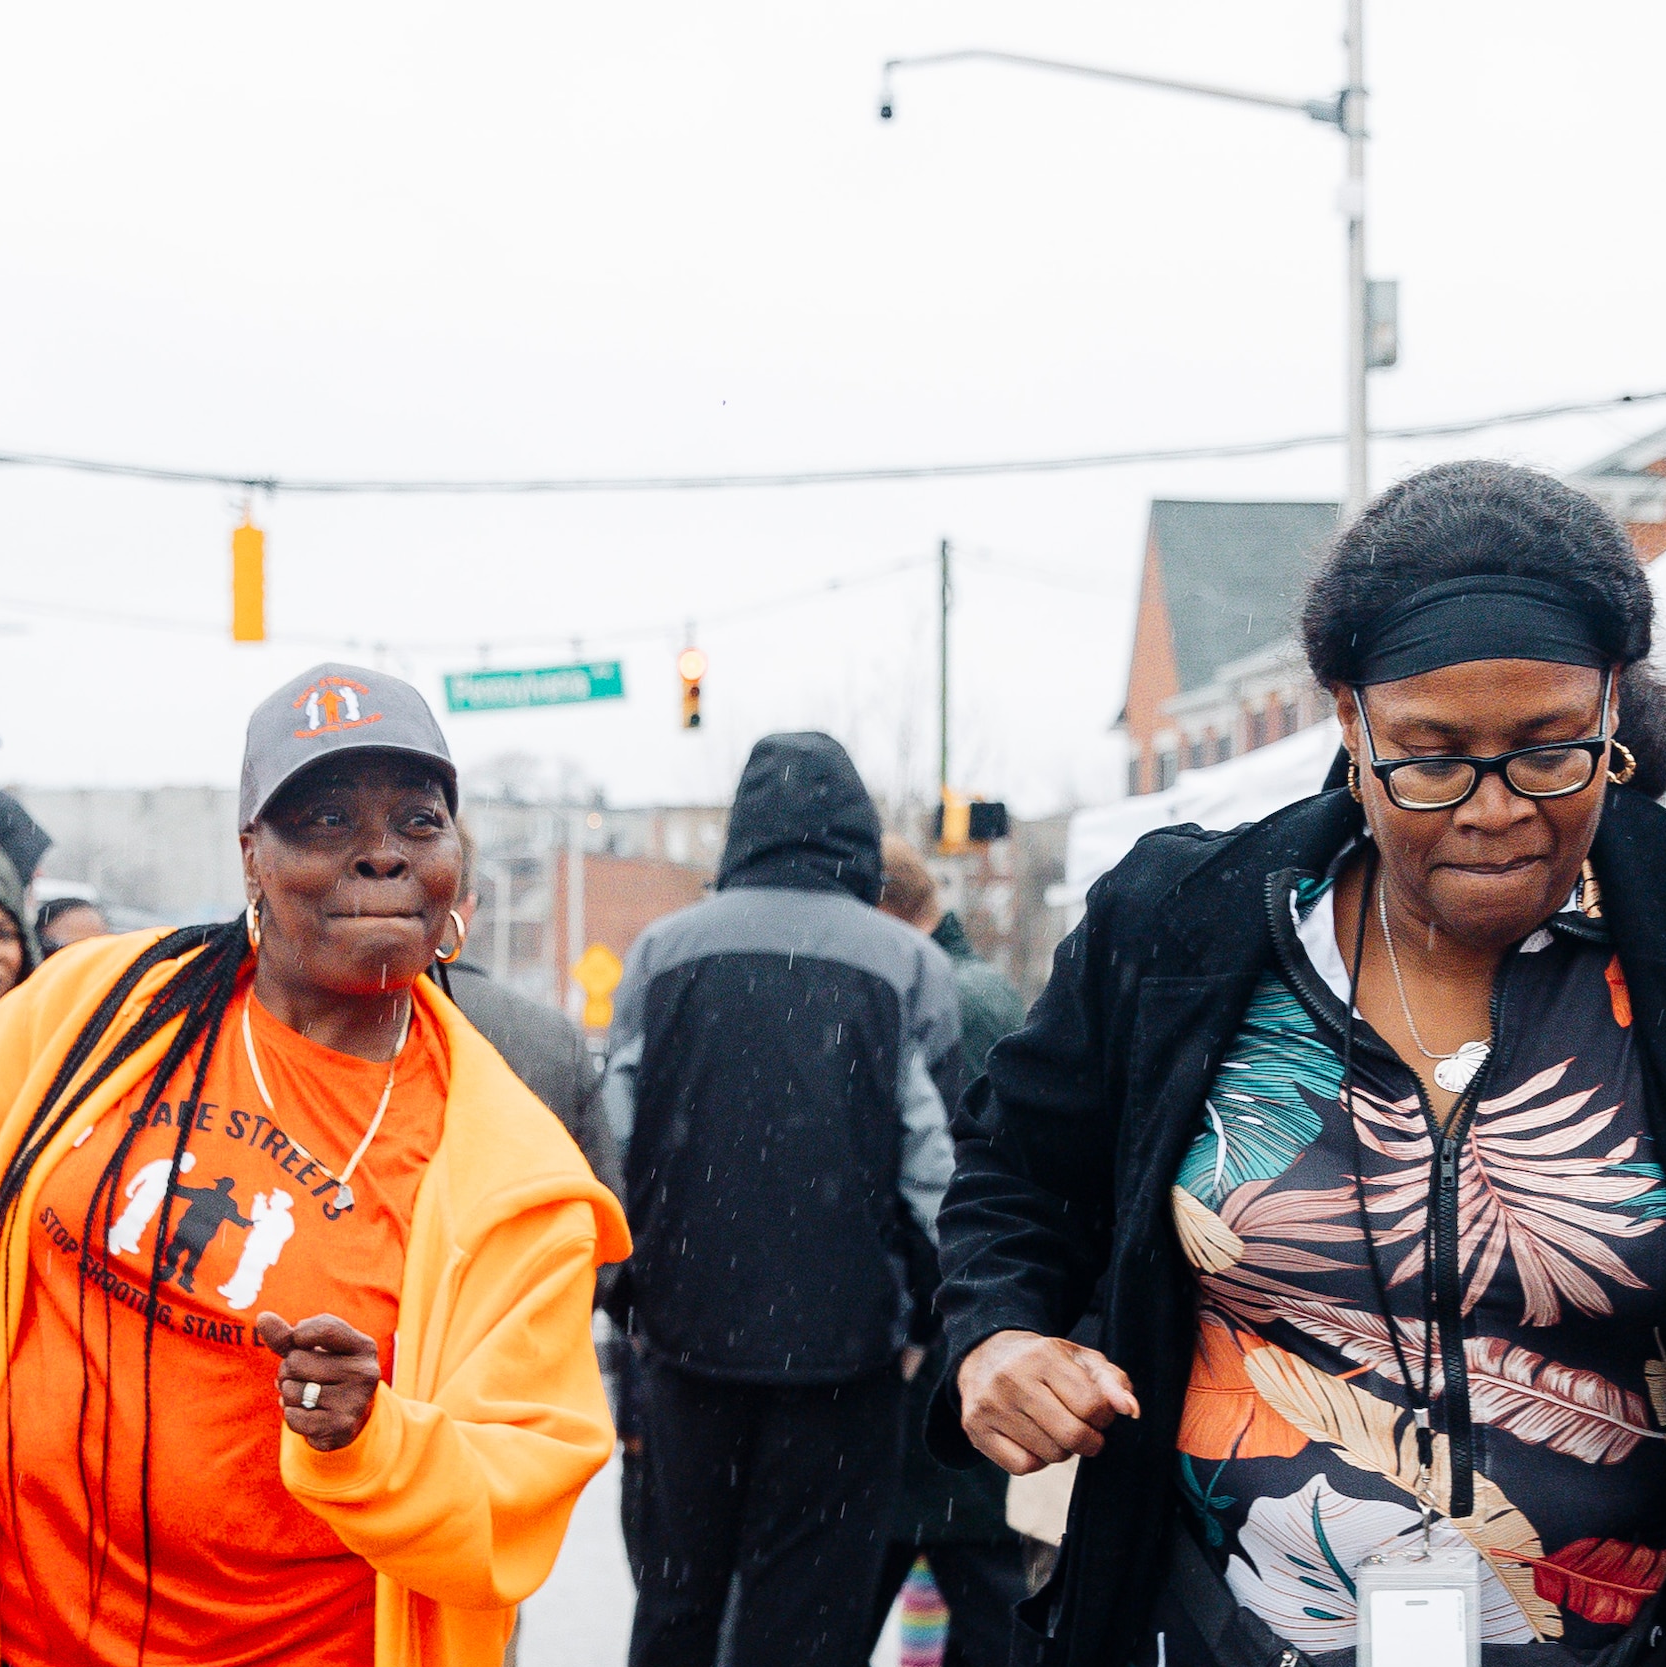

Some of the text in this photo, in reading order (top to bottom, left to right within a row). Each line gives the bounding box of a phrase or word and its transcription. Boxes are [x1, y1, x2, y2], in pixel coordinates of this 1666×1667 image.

[225, 1109, 355, 1221] STREETS
[39, 1206, 80, 1253] STOP
[79, 1253, 175, 1331] SHOOTIG,
[183, 1313, 245, 1347] START
